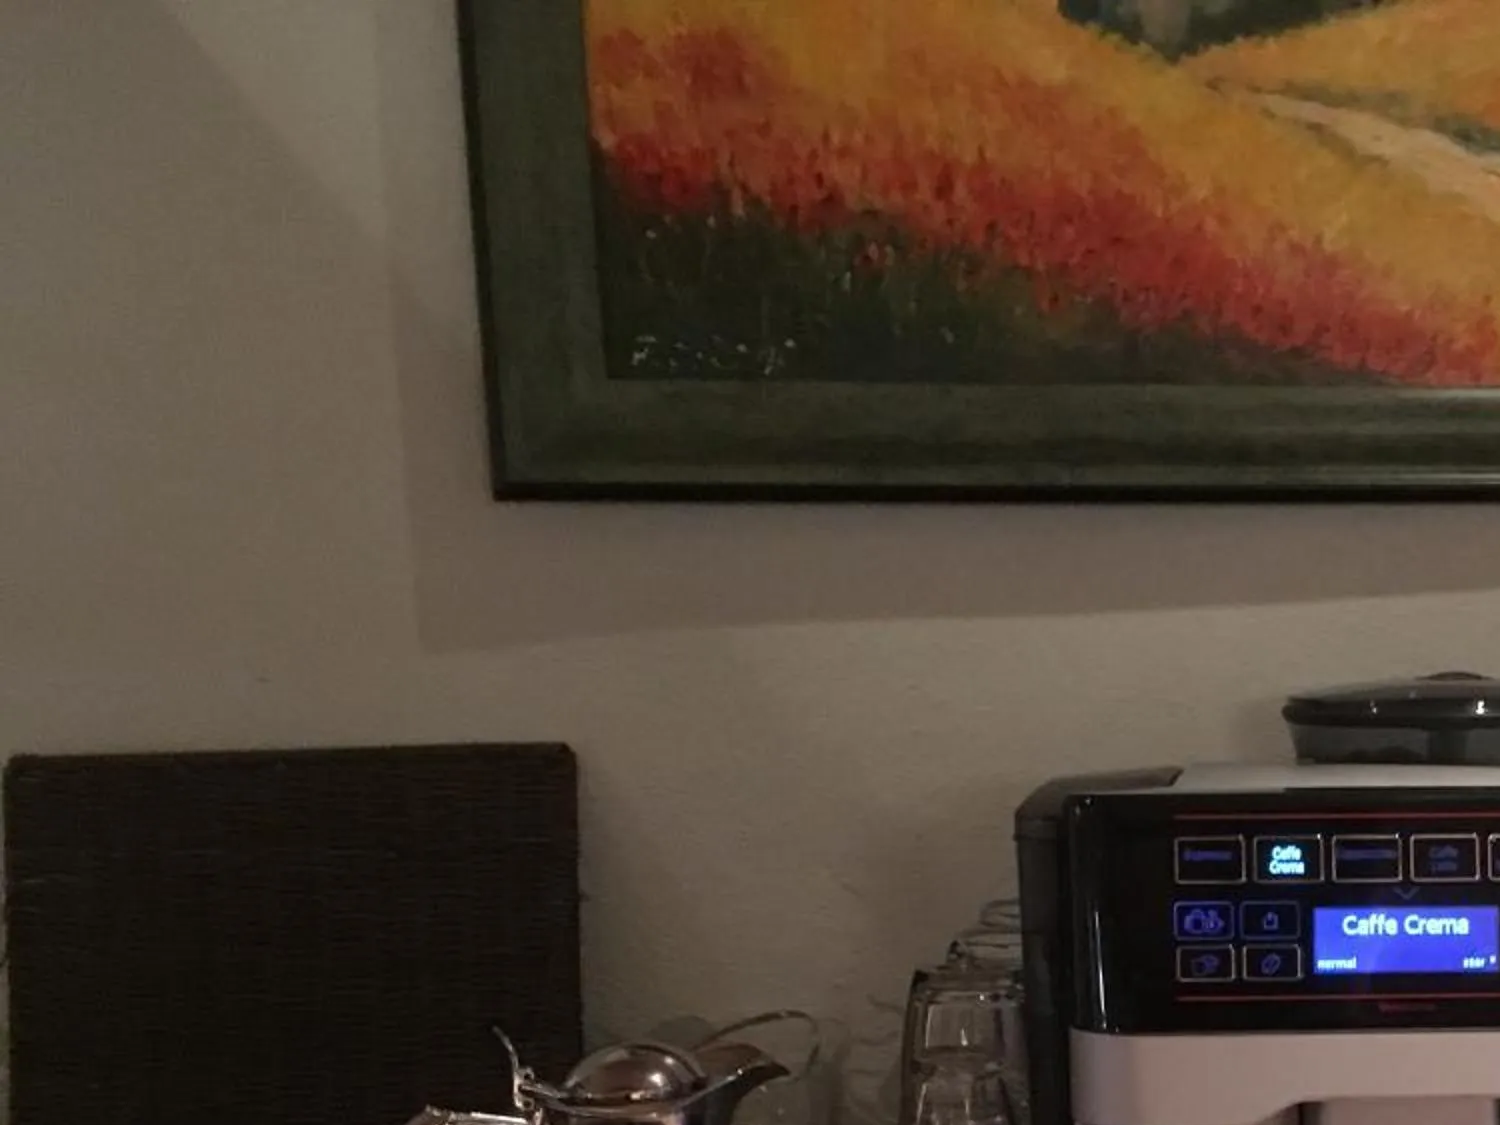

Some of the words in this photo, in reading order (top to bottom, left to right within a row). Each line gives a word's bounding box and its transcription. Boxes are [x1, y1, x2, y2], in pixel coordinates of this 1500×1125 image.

[1342, 913, 1397, 935] Caffe
[1404, 914, 1469, 935] Crema
[1317, 956, 1357, 969] normal
